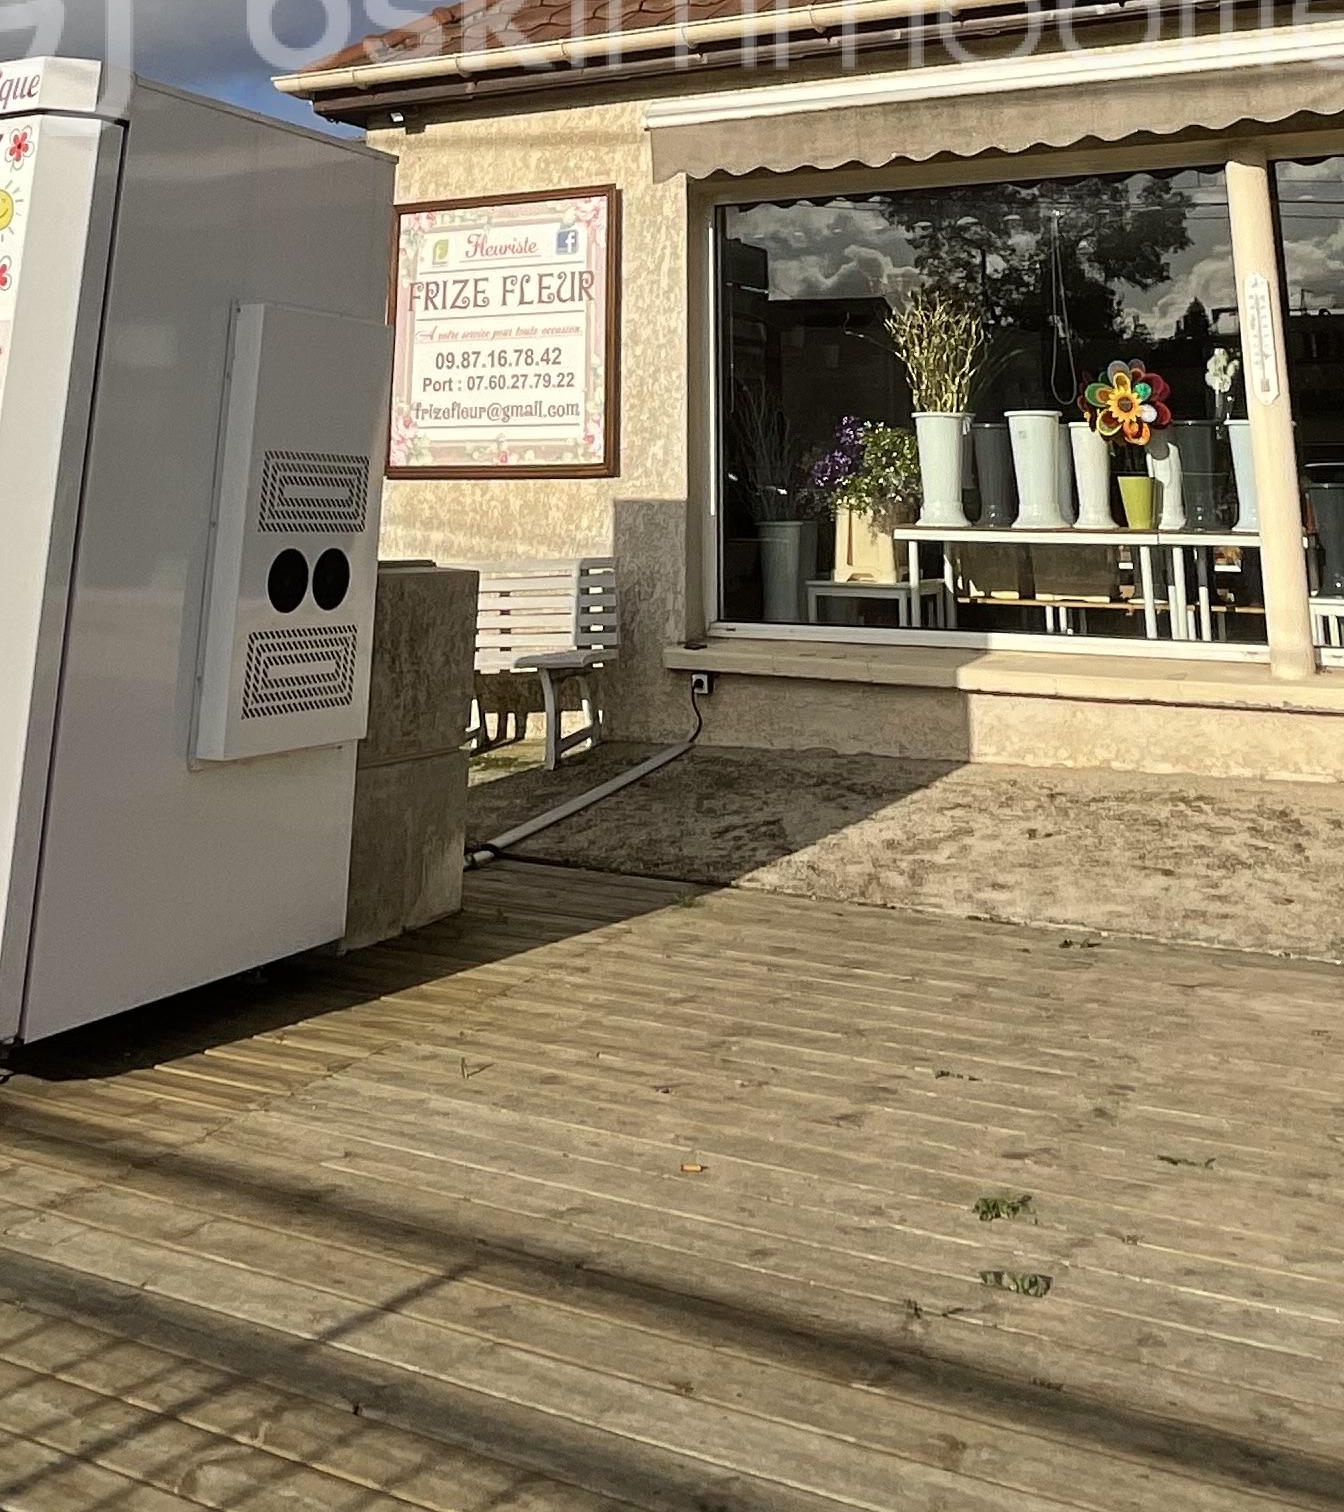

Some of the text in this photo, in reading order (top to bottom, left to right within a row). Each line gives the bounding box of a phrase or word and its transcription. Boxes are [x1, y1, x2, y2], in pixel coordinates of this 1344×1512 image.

[465, 234, 538, 258] Fleuriste
[409, 270, 595, 312] FRIZE FLEUR
[435, 347, 562, 370] 09.87.16.78.42
[422, 377, 454, 392] Port
[467, 372, 575, 391] 07.60.27.79.22
[414, 400, 581, 423] frizefleur@gmail.com
